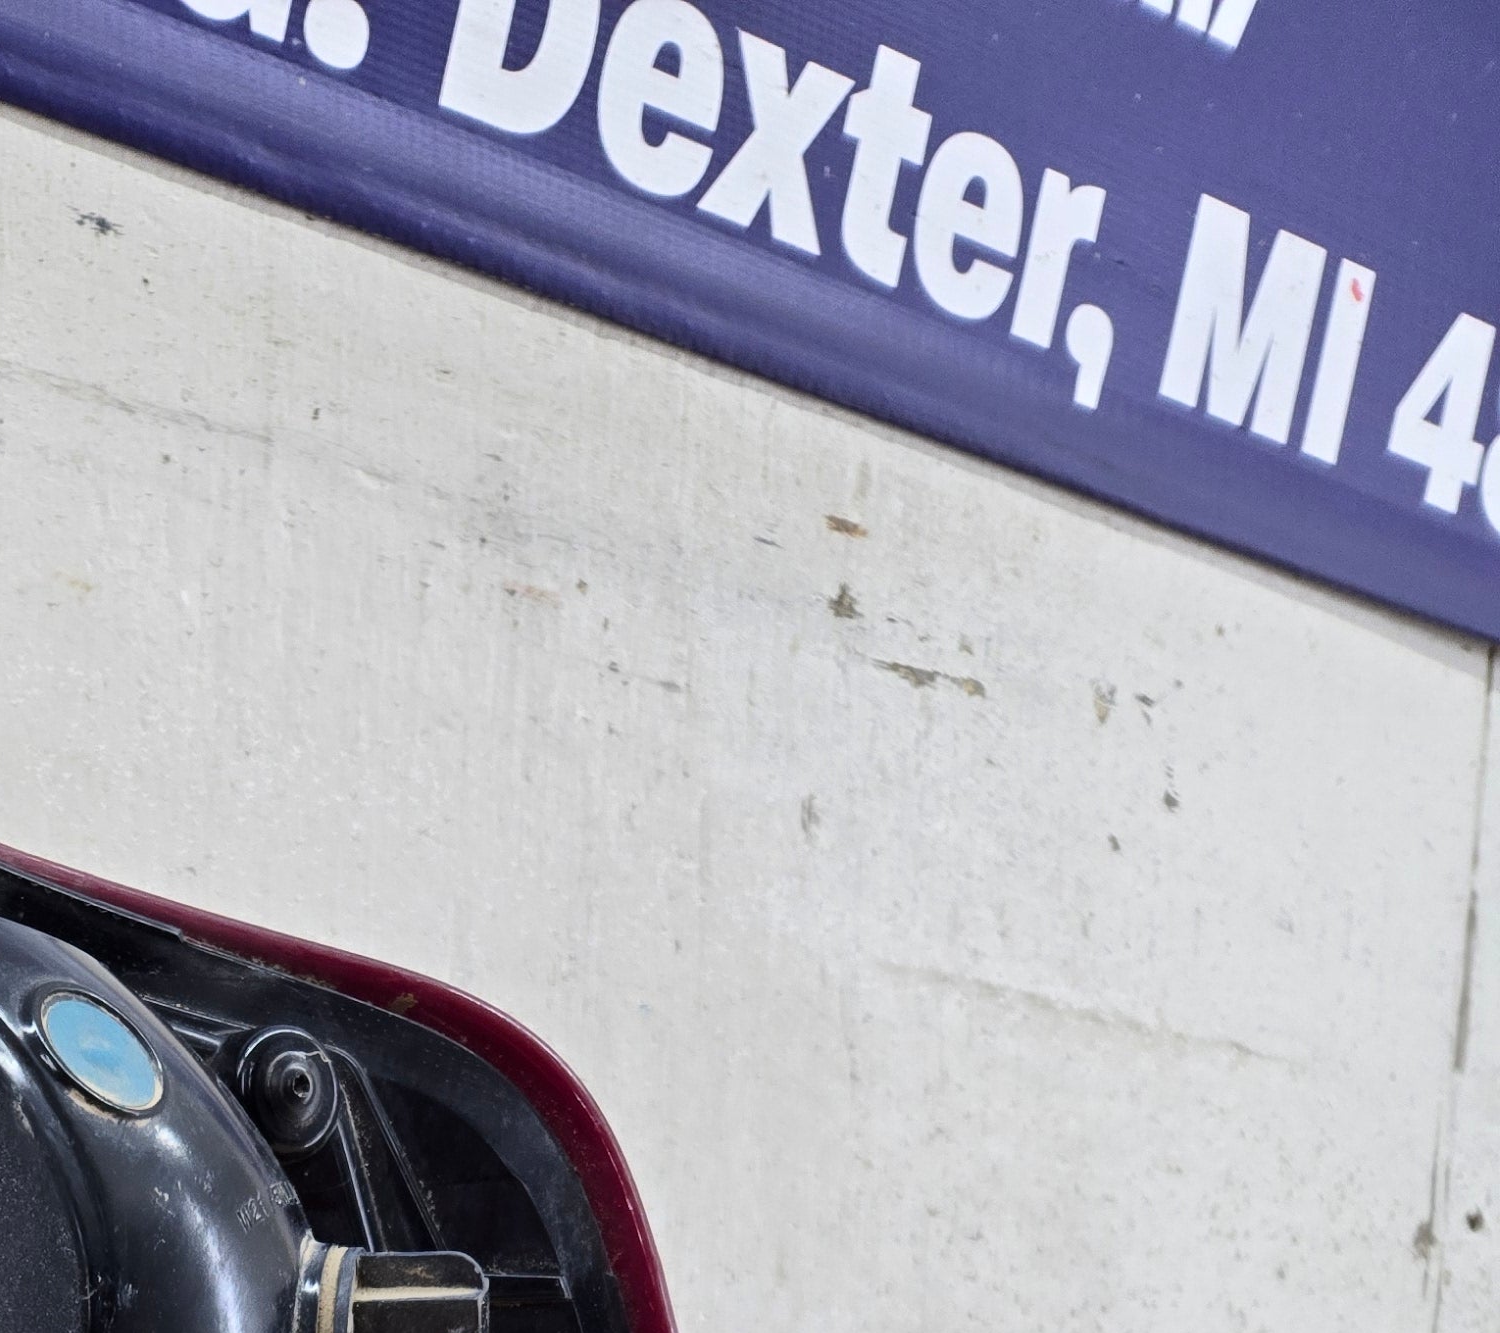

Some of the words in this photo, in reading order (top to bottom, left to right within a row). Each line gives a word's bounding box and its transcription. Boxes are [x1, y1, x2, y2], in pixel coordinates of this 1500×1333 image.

[439, 0, 1113, 409] Dexter,
[1159, 194, 1376, 464] MI
[1388, 313, 1500, 535] 4
